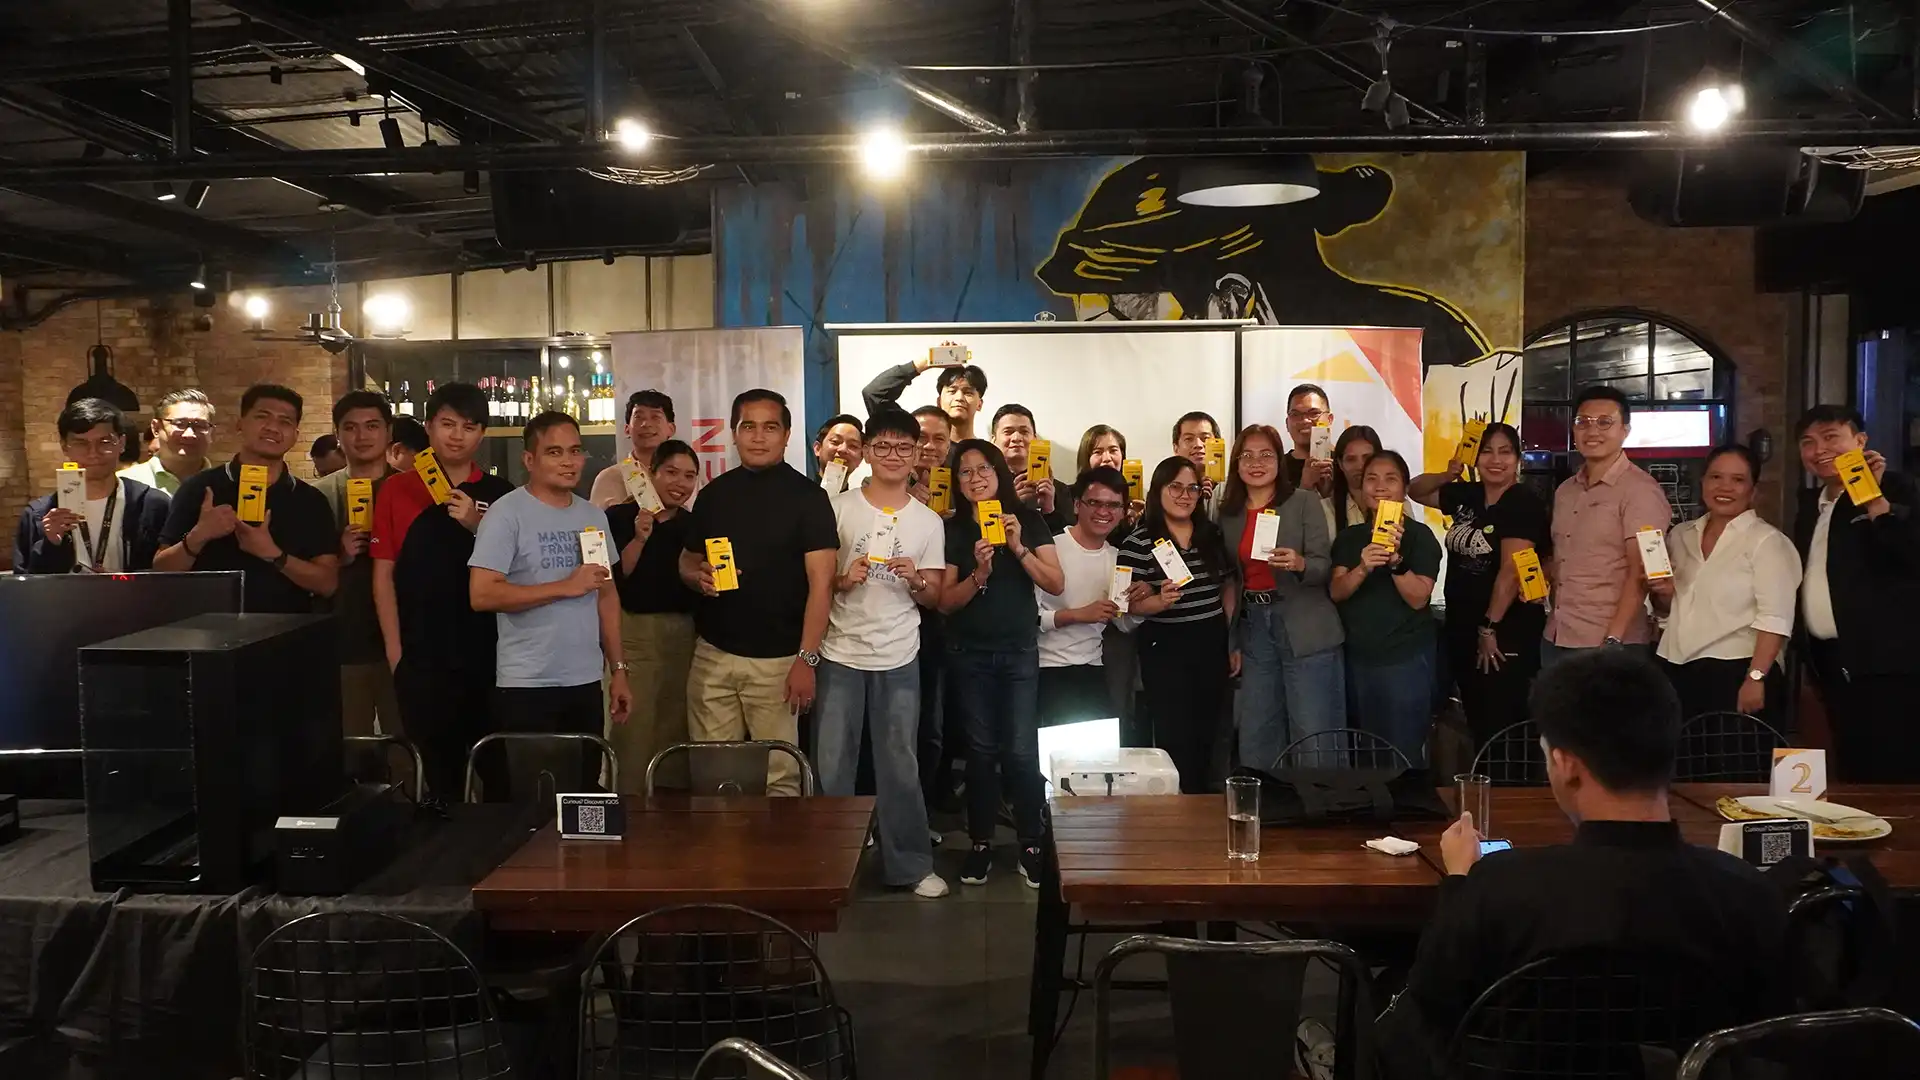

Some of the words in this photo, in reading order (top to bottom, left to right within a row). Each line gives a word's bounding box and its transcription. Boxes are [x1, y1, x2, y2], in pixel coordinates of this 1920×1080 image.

[538, 531, 581, 543] MARIT
[855, 532, 873, 553] BEVE
[540, 543, 581, 556] FRANC
[541, 556, 576, 569] GIRB
[876, 573, 896, 583] CLUB
[1790, 762, 1812, 794] 2
